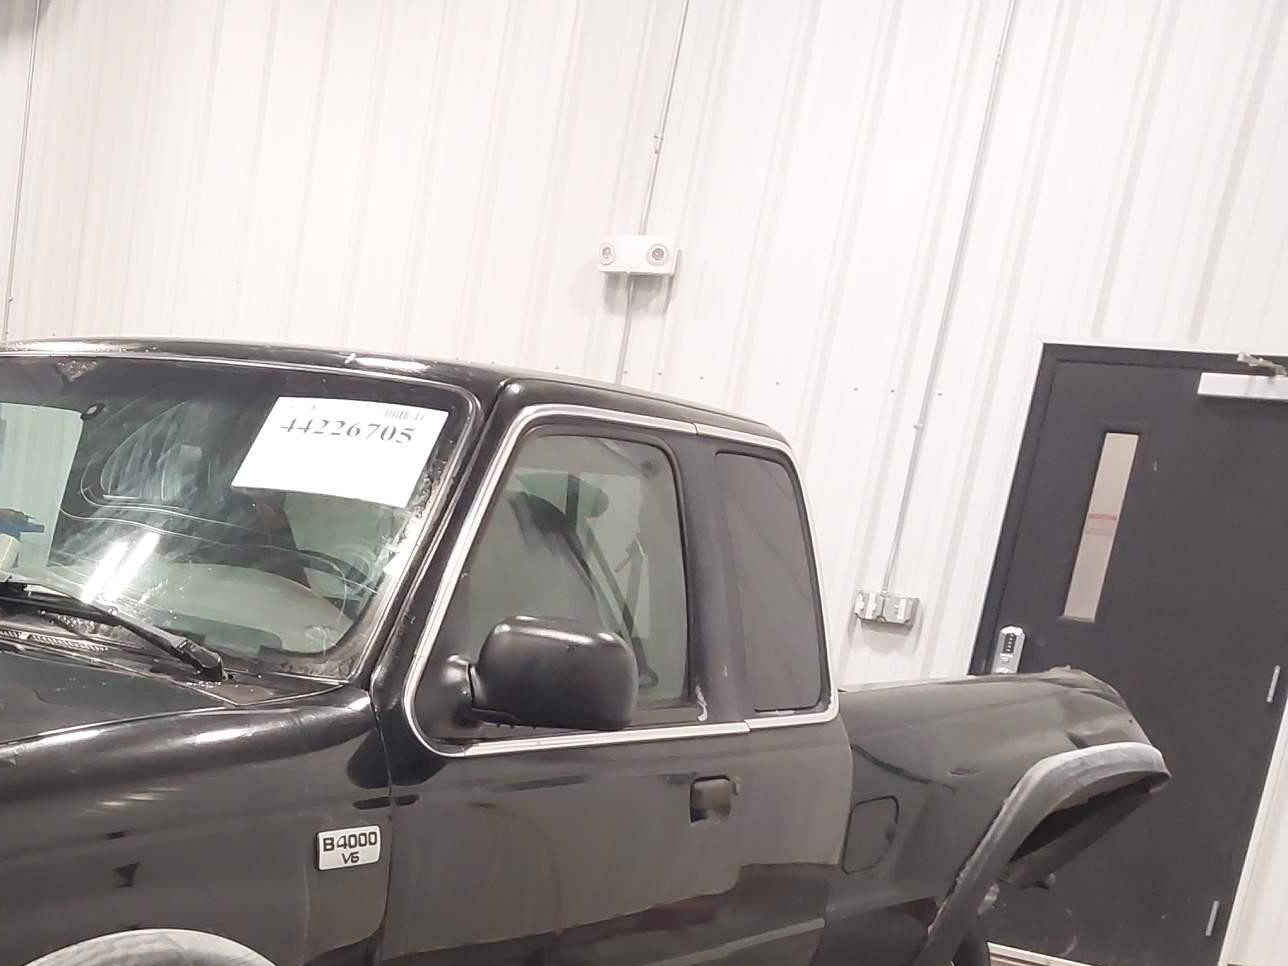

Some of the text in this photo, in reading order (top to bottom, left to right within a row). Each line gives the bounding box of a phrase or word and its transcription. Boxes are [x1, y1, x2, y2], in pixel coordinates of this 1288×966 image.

[280, 417, 416, 444] 44226705
[322, 831, 378, 852] B4000
[341, 851, 360, 865] V6
